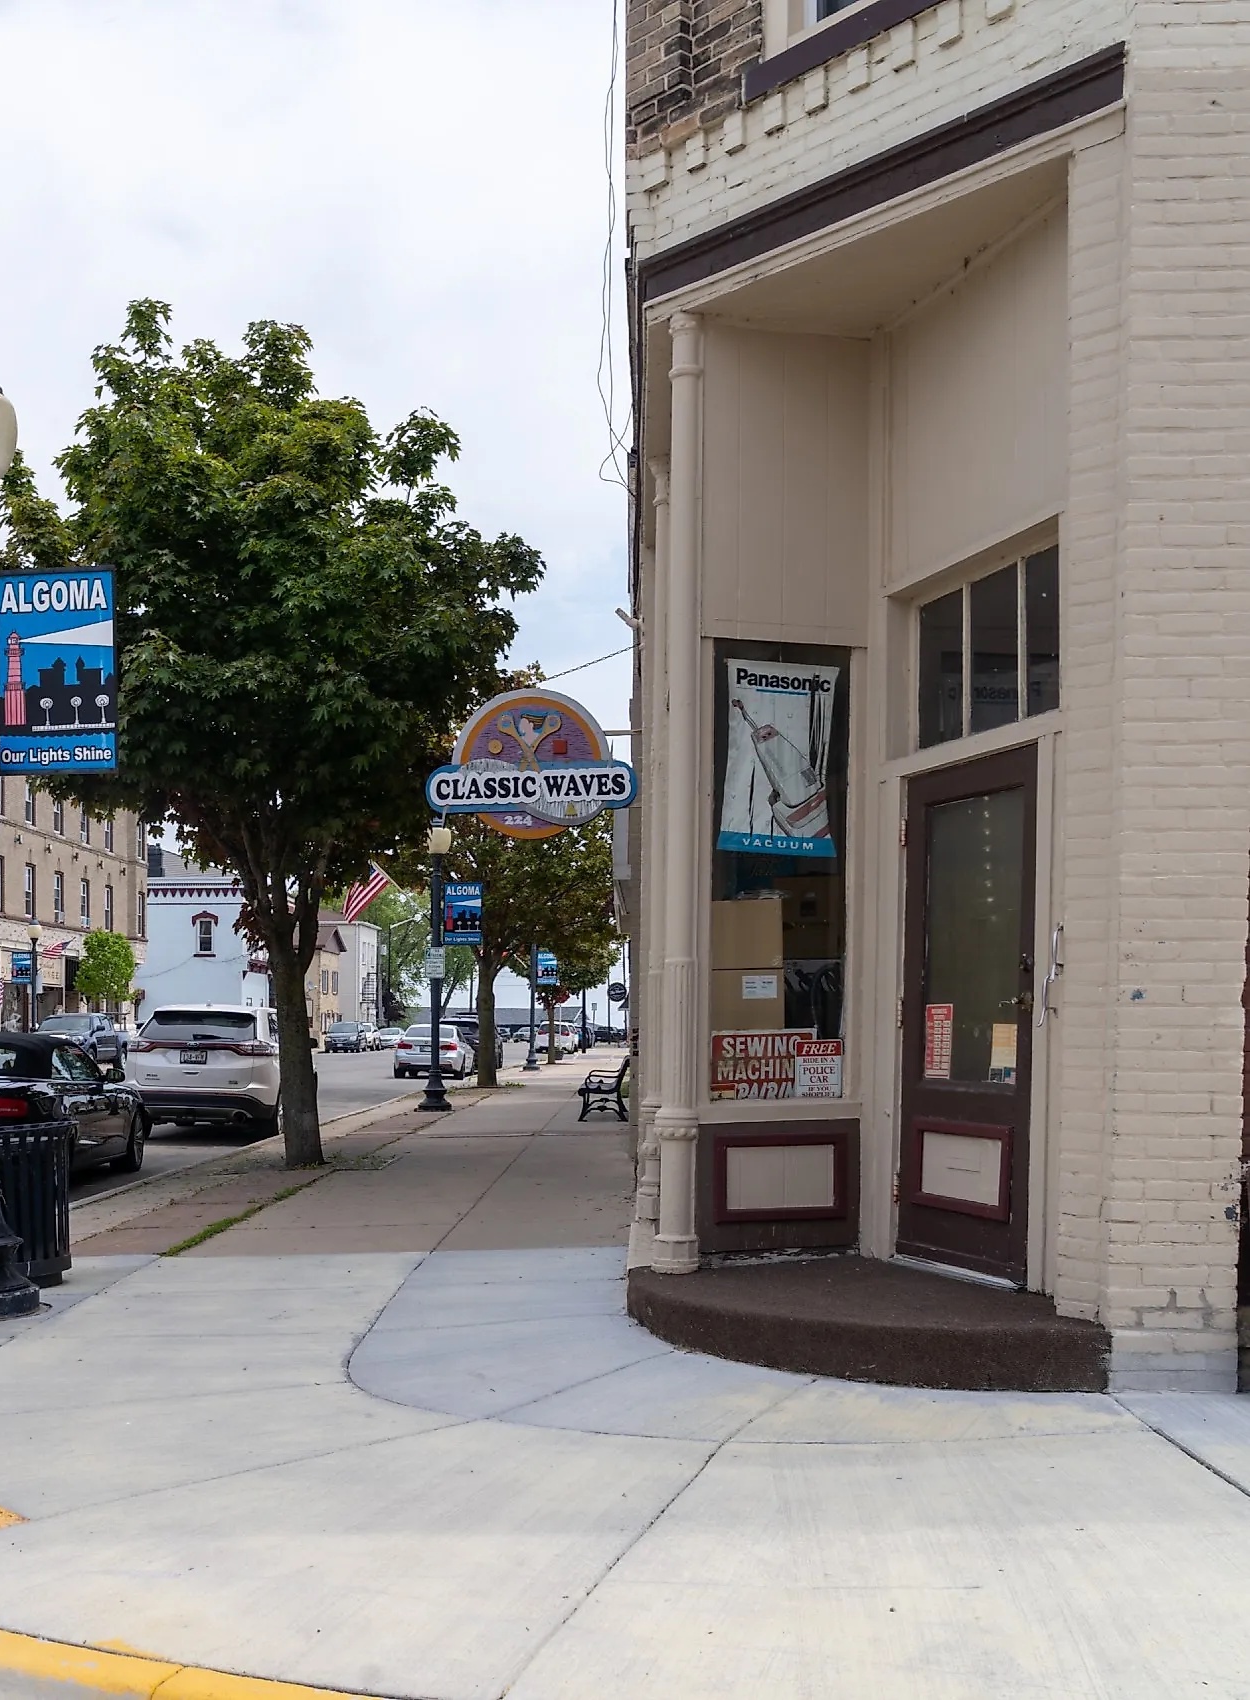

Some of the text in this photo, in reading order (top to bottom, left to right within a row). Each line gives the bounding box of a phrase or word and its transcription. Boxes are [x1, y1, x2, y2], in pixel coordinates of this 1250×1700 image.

[0, 578, 108, 614] ALGOMA
[736, 667, 831, 693] Panasonic
[1, 746, 112, 765] Our Lights Shine
[435, 773, 626, 801] CLASSIC WAVES
[502, 814, 533, 826] 224
[742, 838, 814, 850] VACUUM
[446, 886, 481, 896] ALGOMA
[801, 1043, 837, 1055] FREE
[717, 1058, 796, 1081] MACHIN
[802, 1066, 835, 1075] POLICE
[810, 1075, 829, 1083] CAR
